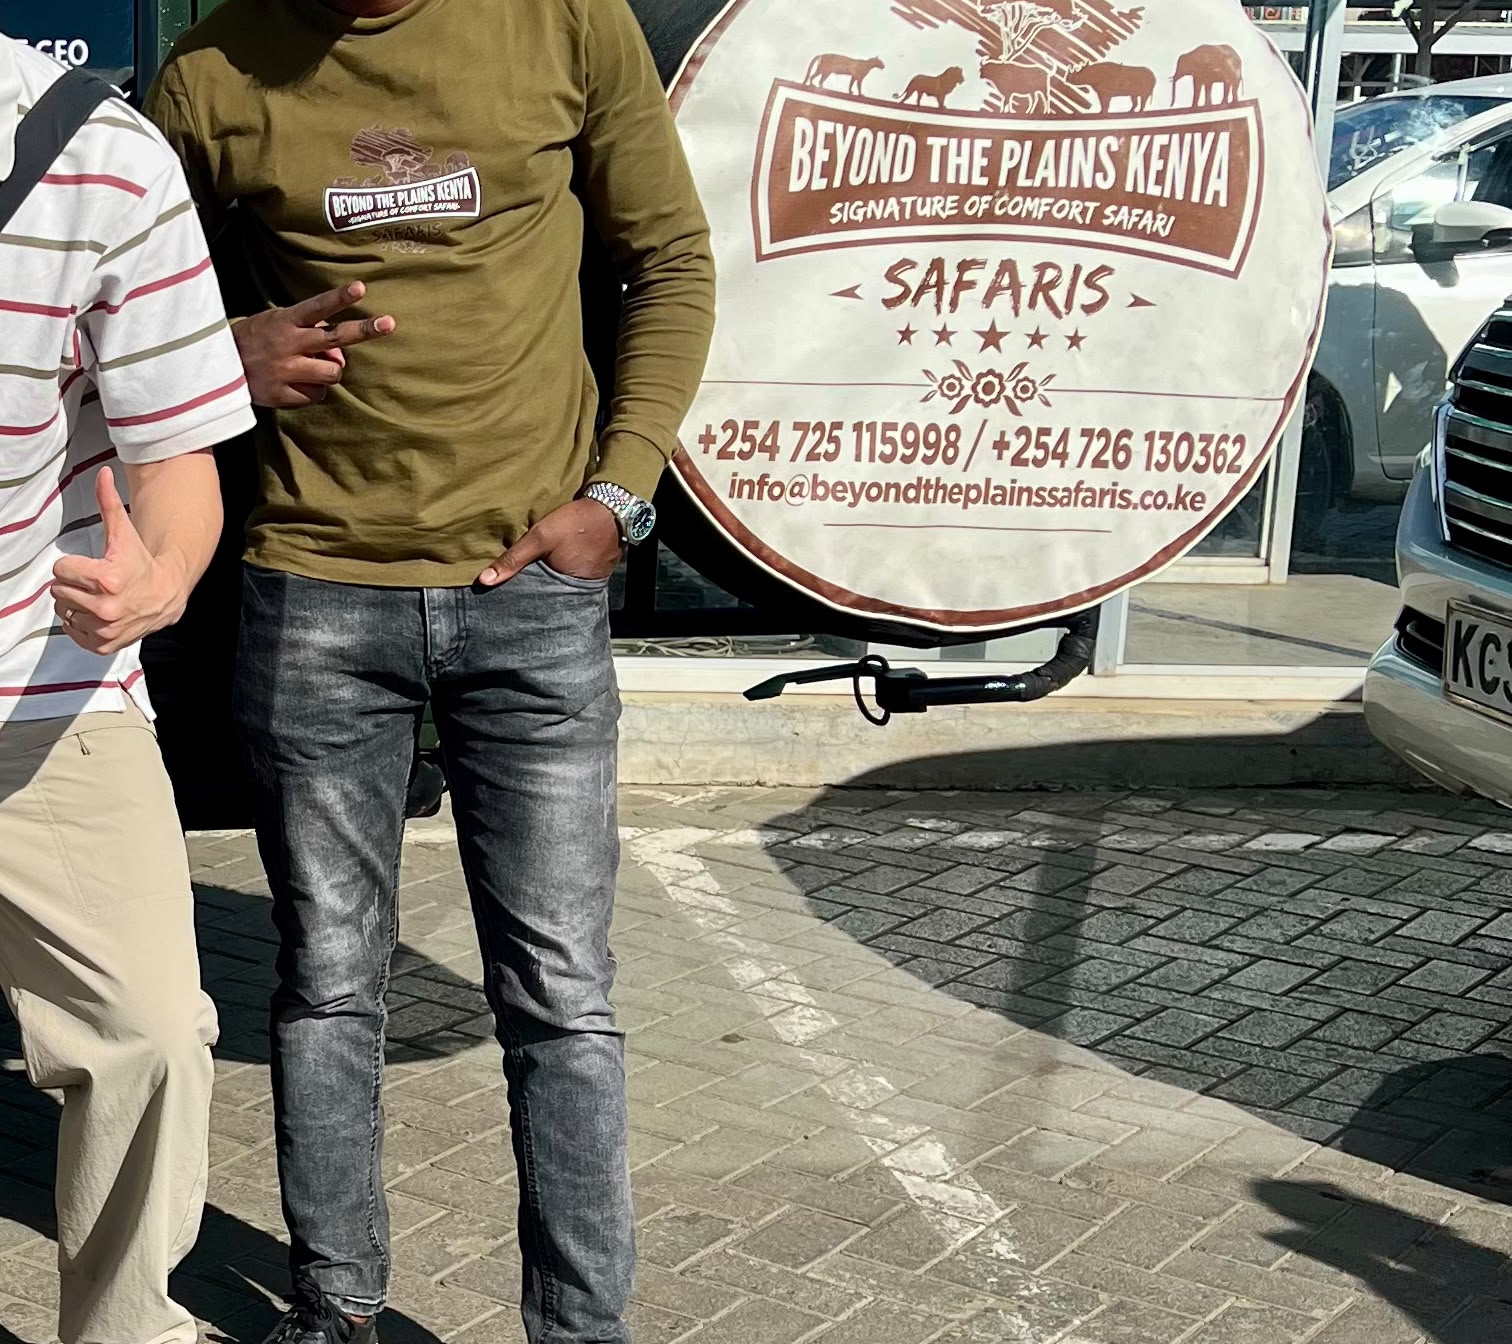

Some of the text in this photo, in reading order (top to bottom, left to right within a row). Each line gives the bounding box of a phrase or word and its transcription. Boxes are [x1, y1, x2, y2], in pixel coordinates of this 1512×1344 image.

[788, 116, 1231, 208] BEYOND THE PLAINS KENYA
[332, 175, 472, 218] BEYOND THE PLAINS KENYA
[829, 194, 1176, 238] SIGNATURE OF COMFORT SAFARI
[372, 222, 443, 242] SAFARIS
[881, 256, 1116, 320] SAFARIS
[698, 418, 1247, 474] +254 725 115998 / +254 726 130362
[728, 472, 1206, 512] info@beyondtheplainssafaris.co.ke
